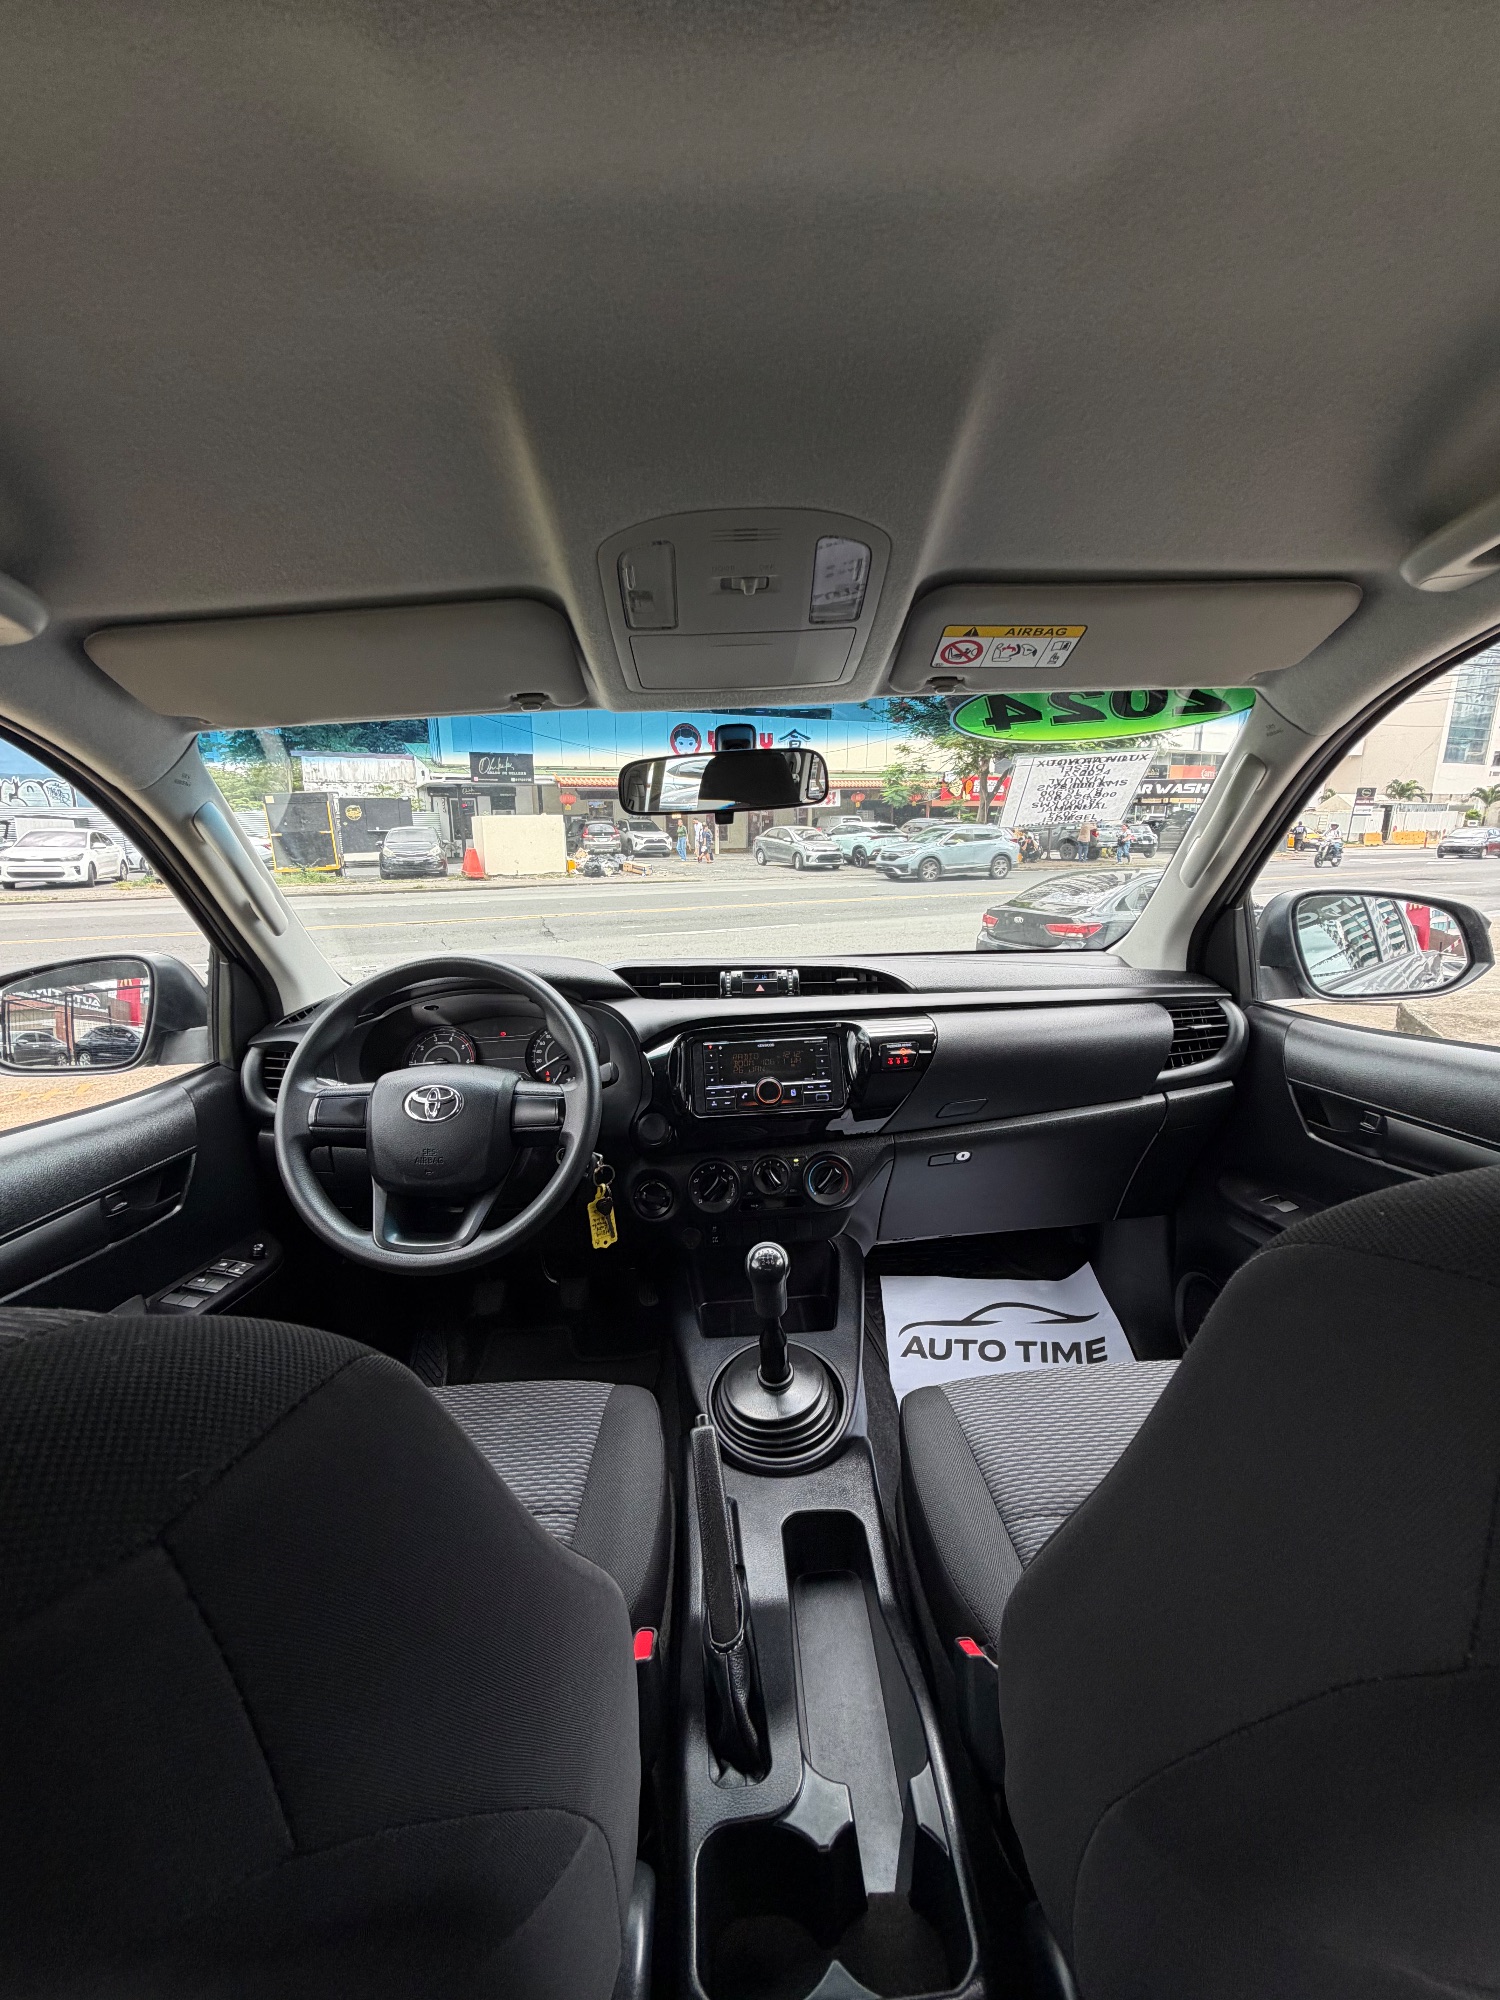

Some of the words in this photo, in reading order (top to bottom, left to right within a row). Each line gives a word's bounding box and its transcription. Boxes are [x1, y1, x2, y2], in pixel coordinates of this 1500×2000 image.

[1004, 627, 1068, 637] AIRBAG
[1156, 783, 1211, 794] WASH
[415, 1156, 445, 1165] AIRBAG
[900, 1335, 1007, 1362] AUTO
[1015, 1336, 1108, 1365] TIME
